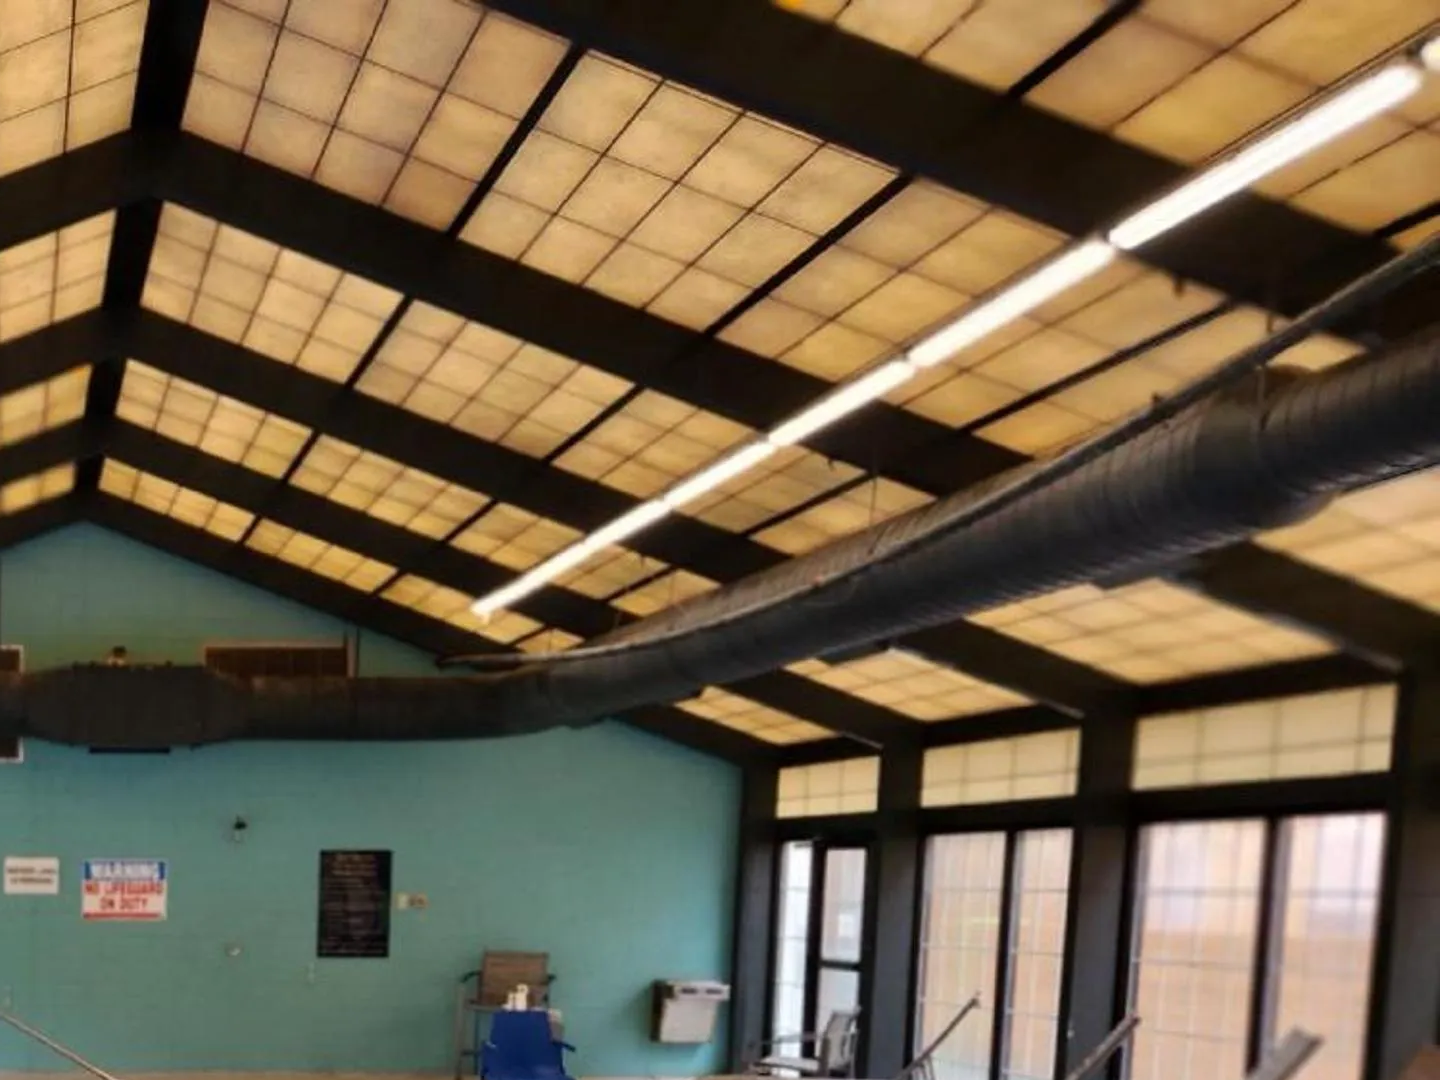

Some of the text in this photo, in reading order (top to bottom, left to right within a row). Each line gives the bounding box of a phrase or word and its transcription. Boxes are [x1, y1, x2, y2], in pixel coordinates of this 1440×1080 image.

[90, 863, 160, 880] WARNING
[85, 882, 163, 895] NO LIFEGUARD
[100, 898, 148, 909] ON DUTY
